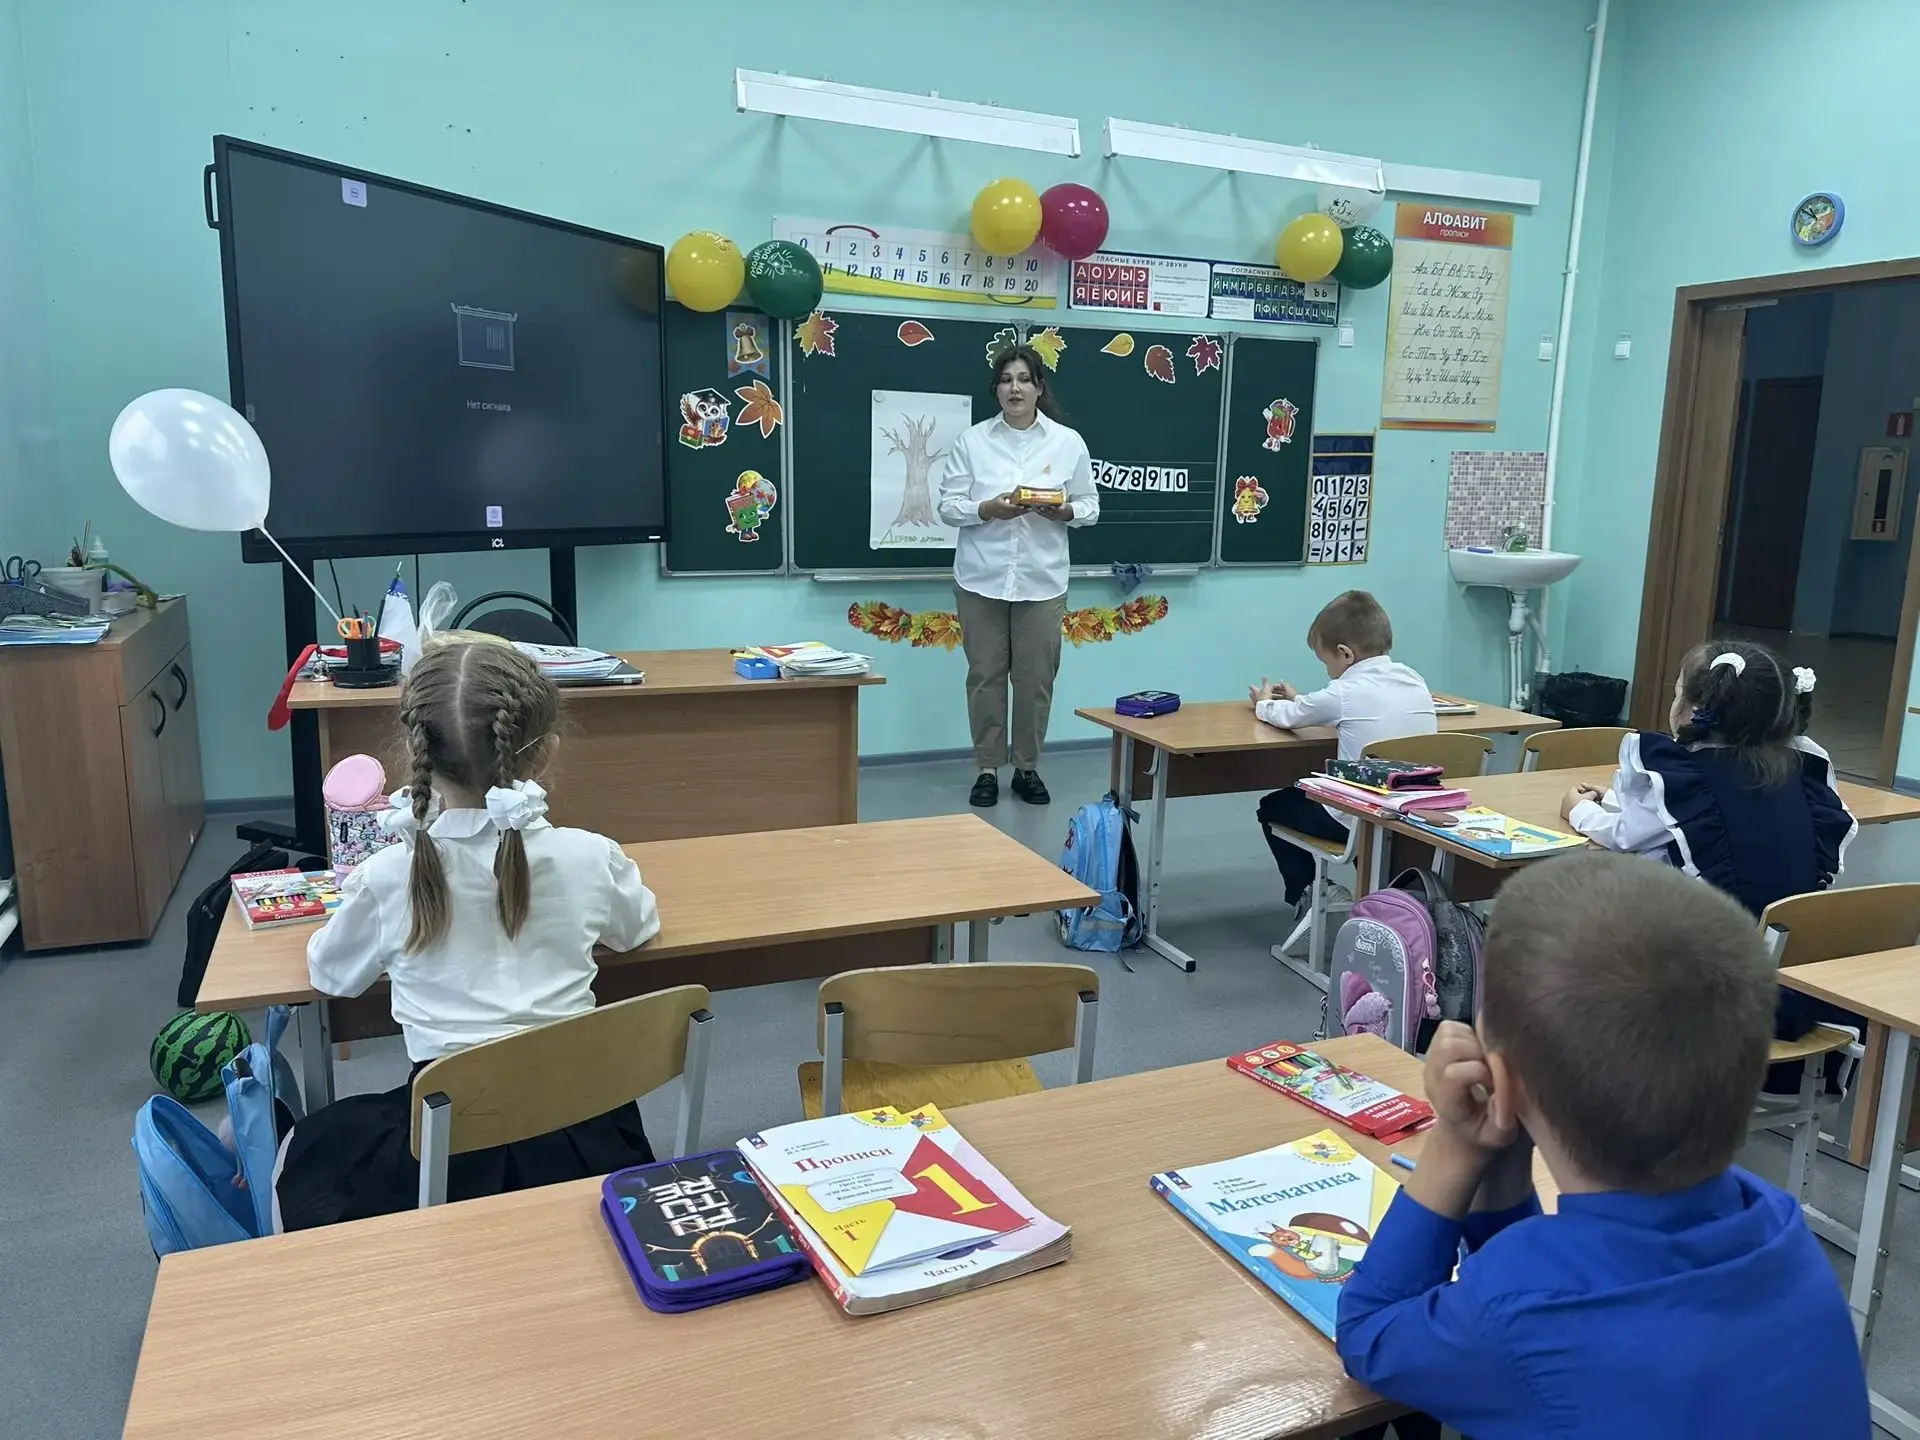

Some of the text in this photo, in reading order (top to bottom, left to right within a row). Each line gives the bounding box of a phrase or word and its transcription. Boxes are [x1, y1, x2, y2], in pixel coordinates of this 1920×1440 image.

[1423, 211, 1488, 230] АЛФАВИТ
[825, 241, 831, 254] 1
[849, 242, 857, 256] 2
[872, 245, 881, 258] 3
[896, 247, 904, 260] 4
[918, 249, 927, 262] 5
[941, 251, 949, 264] 6
[963, 253, 971, 266] 7
[985, 255, 993, 268] 8
[1007, 257, 1015, 270] 9
[1025, 259, 1038, 272] 10
[1096, 256, 1129, 264] ГЛАСНЫЕ
[823, 262, 1039, 292] 11 12 13 14 15 16 17 18 19 20
[1231, 267, 1270, 276] СОГЛАСНЫЕ
[1344, 478, 1354, 495] 2
[1359, 478, 1368, 495] 3
[1328, 501, 1337, 518] 5
[1343, 499, 1352, 515] 6
[1358, 500, 1368, 517] 7
[1311, 522, 1321, 538] 8
[1327, 523, 1337, 539] 9
[793, 1148, 893, 1173] Прописи
[912, 1162, 999, 1216] 1
[1206, 1171, 1361, 1216] Математика
[834, 1218, 867, 1232] Часть
[923, 1264, 968, 1277] Часть
